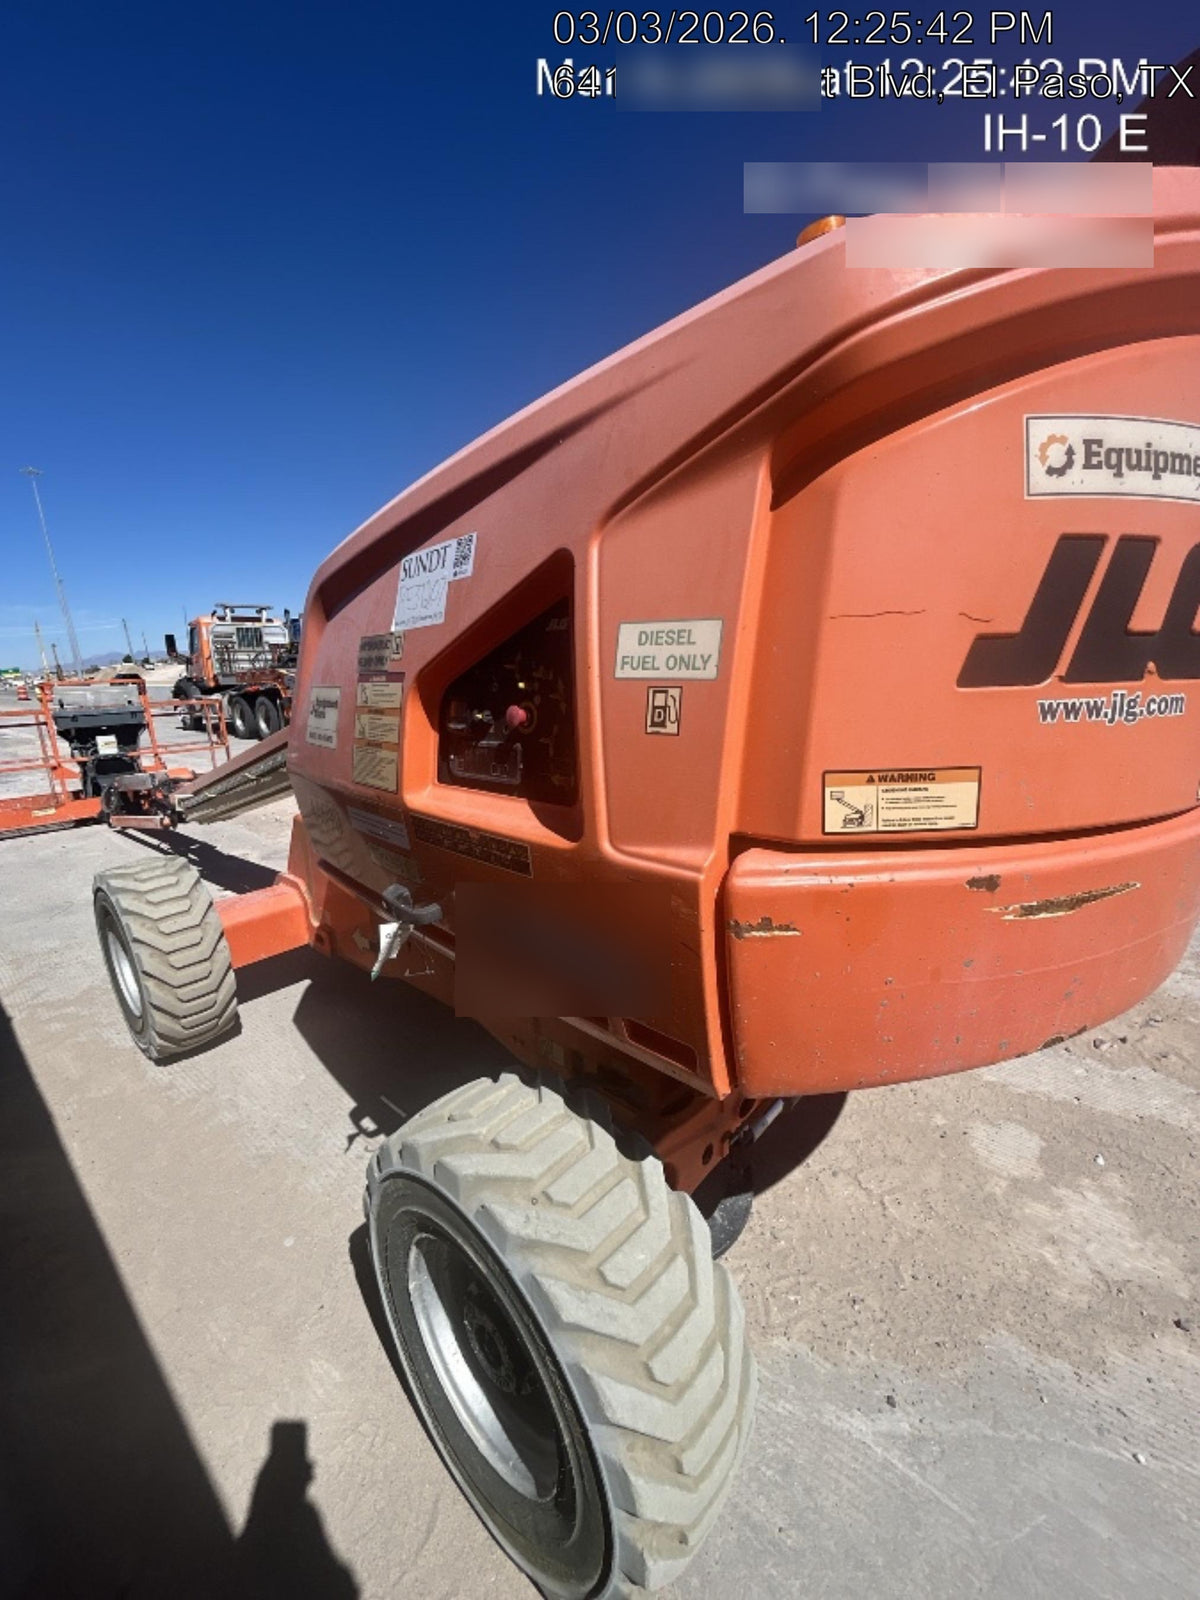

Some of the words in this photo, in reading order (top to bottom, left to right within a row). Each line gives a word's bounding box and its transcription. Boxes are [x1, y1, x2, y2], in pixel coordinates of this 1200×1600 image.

[401, 543, 452, 582] SUNDT
[637, 629, 696, 646] DIESEL
[620, 655, 660, 671] FUEL
[665, 653, 712, 672] ONLY
[1038, 690, 1186, 725] www.jlg.com
[878, 772, 936, 784] WARNING
